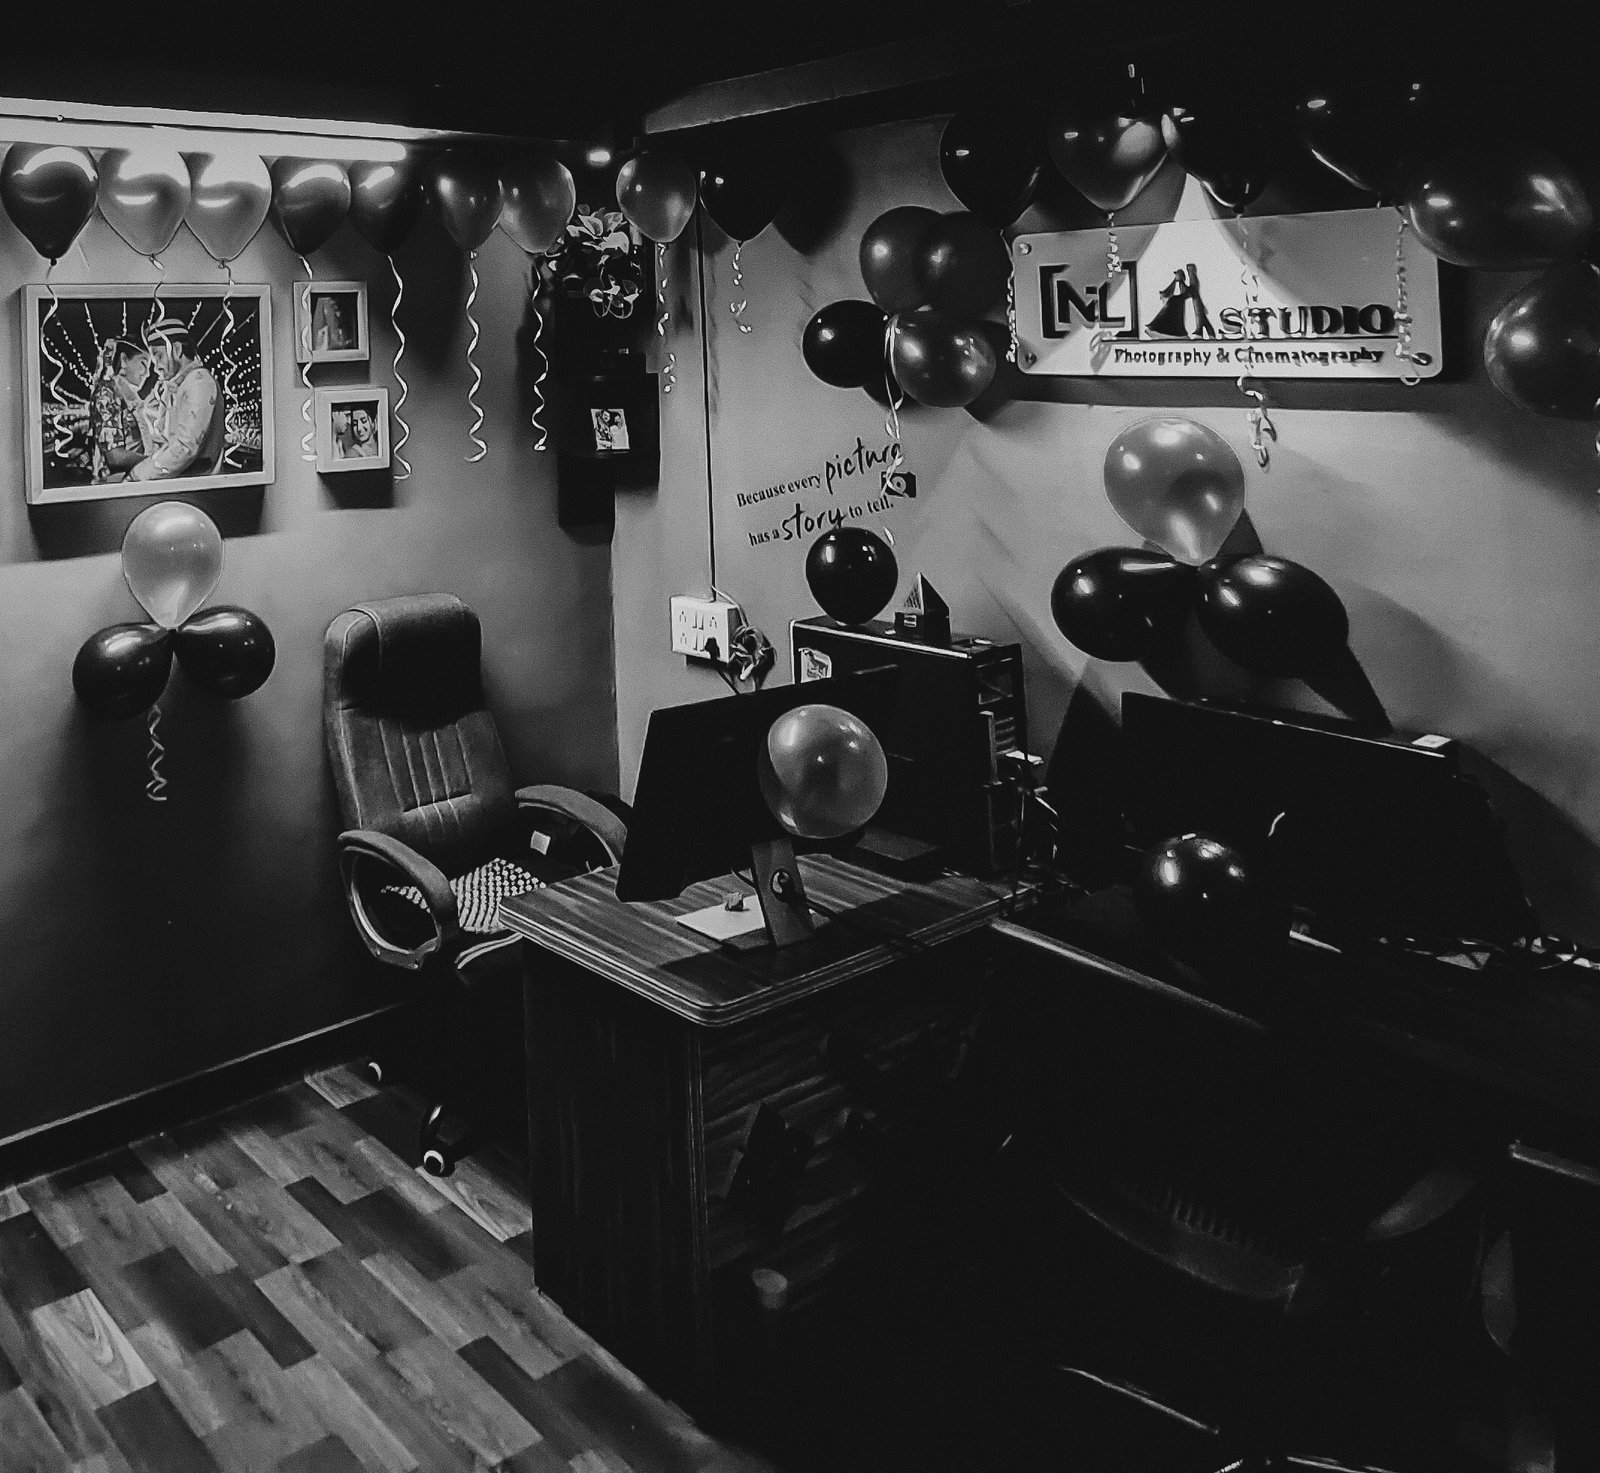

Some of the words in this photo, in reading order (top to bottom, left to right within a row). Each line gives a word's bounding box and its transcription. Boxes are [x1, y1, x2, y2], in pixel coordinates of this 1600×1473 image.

[1218, 304, 1396, 339] STUDIO
[1114, 347, 1212, 367] Photography
[1216, 347, 1230, 363] &
[1234, 345, 1385, 367] Cinematography
[736, 485, 787, 508] Because
[788, 474, 821, 494] every
[825, 437, 902, 495] picture
[748, 532, 771, 547] has
[773, 529, 780, 540] a
[781, 503, 847, 541] story
[848, 505, 863, 519] to
[866, 495, 894, 515] tell.
